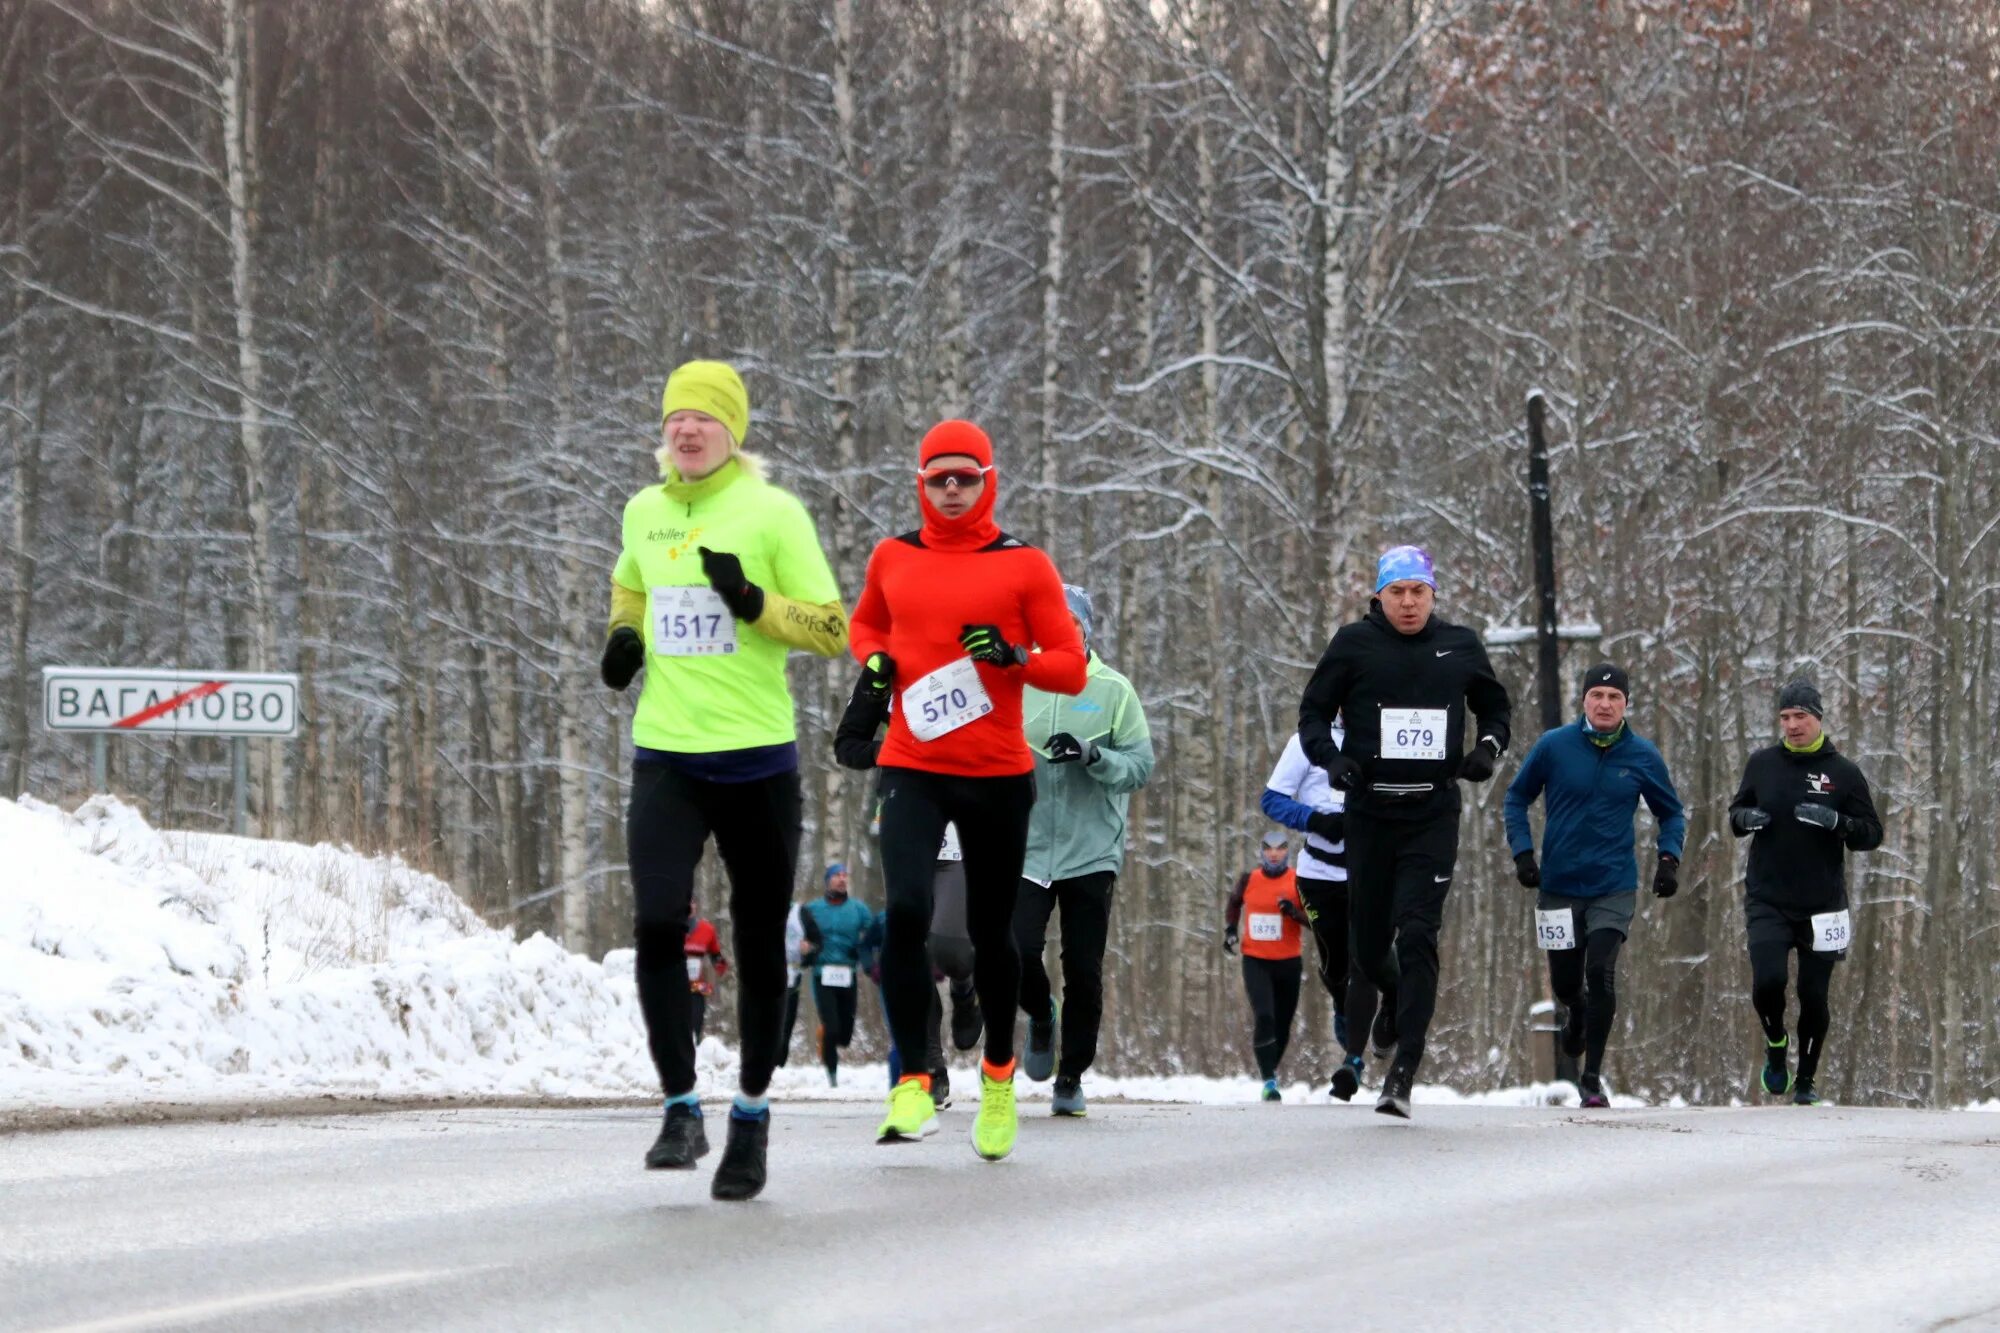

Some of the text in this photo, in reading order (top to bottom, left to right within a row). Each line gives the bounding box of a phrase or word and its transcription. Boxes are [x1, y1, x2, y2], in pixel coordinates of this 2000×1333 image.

[647, 528, 686, 541] Achilles
[660, 613, 722, 639] 1517
[922, 688, 967, 723] 570
[1396, 729, 1433, 747] 679
[1538, 925, 1566, 940] 153
[1825, 926, 1846, 942] 538
